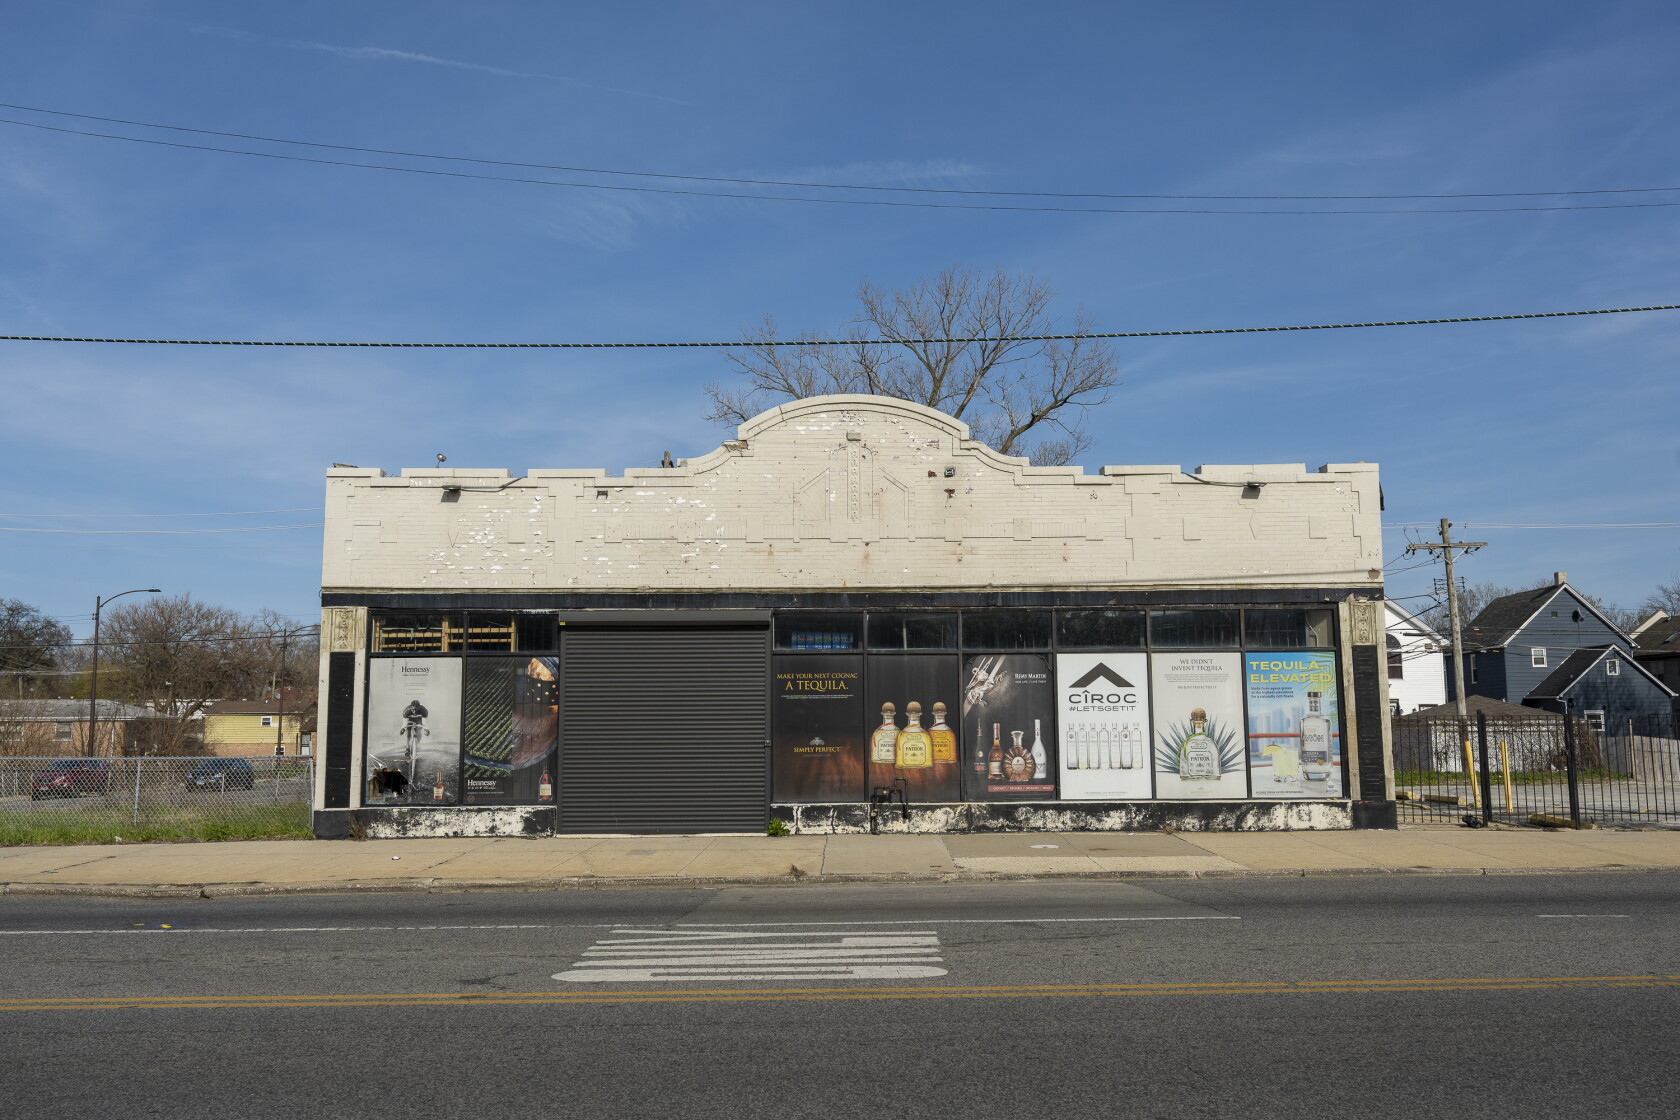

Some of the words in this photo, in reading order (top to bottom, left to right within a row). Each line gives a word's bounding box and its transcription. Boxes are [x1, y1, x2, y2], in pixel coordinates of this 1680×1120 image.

[785, 681, 794, 690] A
[796, 680, 849, 692] TEQUILA.
[467, 779, 496, 787] Hennessy
